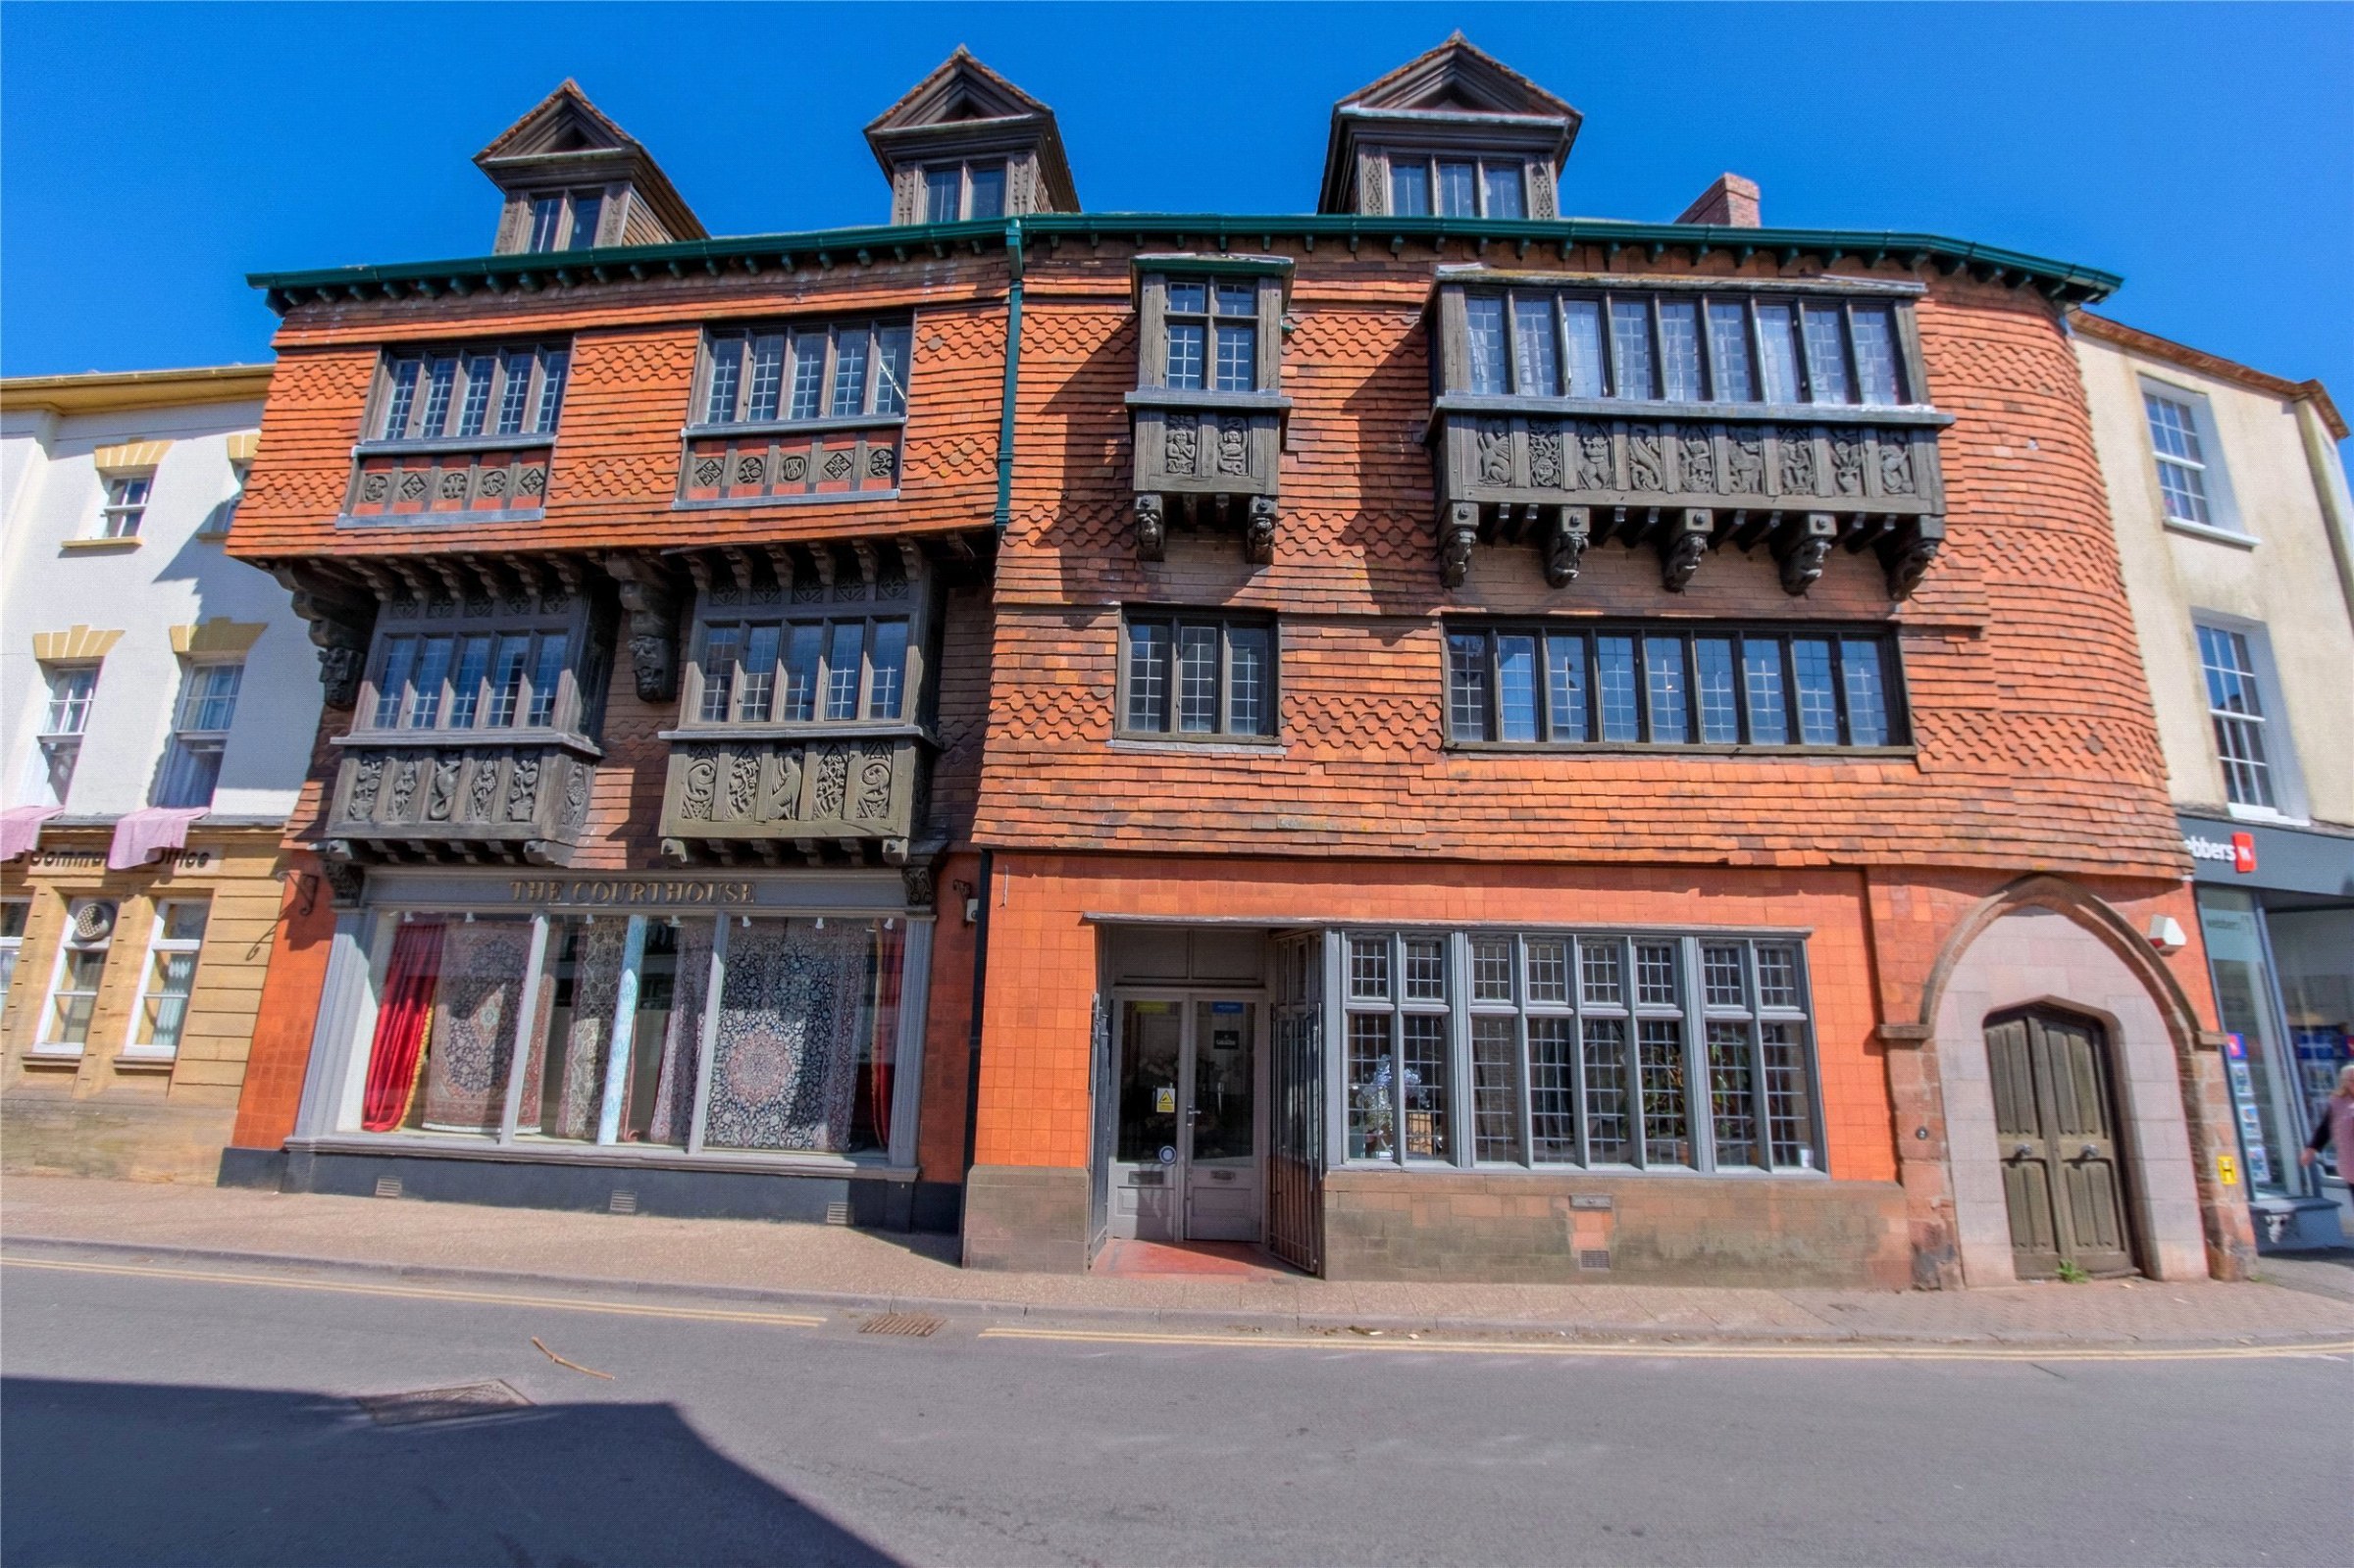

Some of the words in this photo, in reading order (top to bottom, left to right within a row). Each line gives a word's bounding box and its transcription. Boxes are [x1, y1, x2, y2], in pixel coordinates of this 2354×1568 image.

[29, 846, 108, 867] Commu
[510, 881, 562, 902] THE
[571, 881, 756, 903] COURTHOUSE
